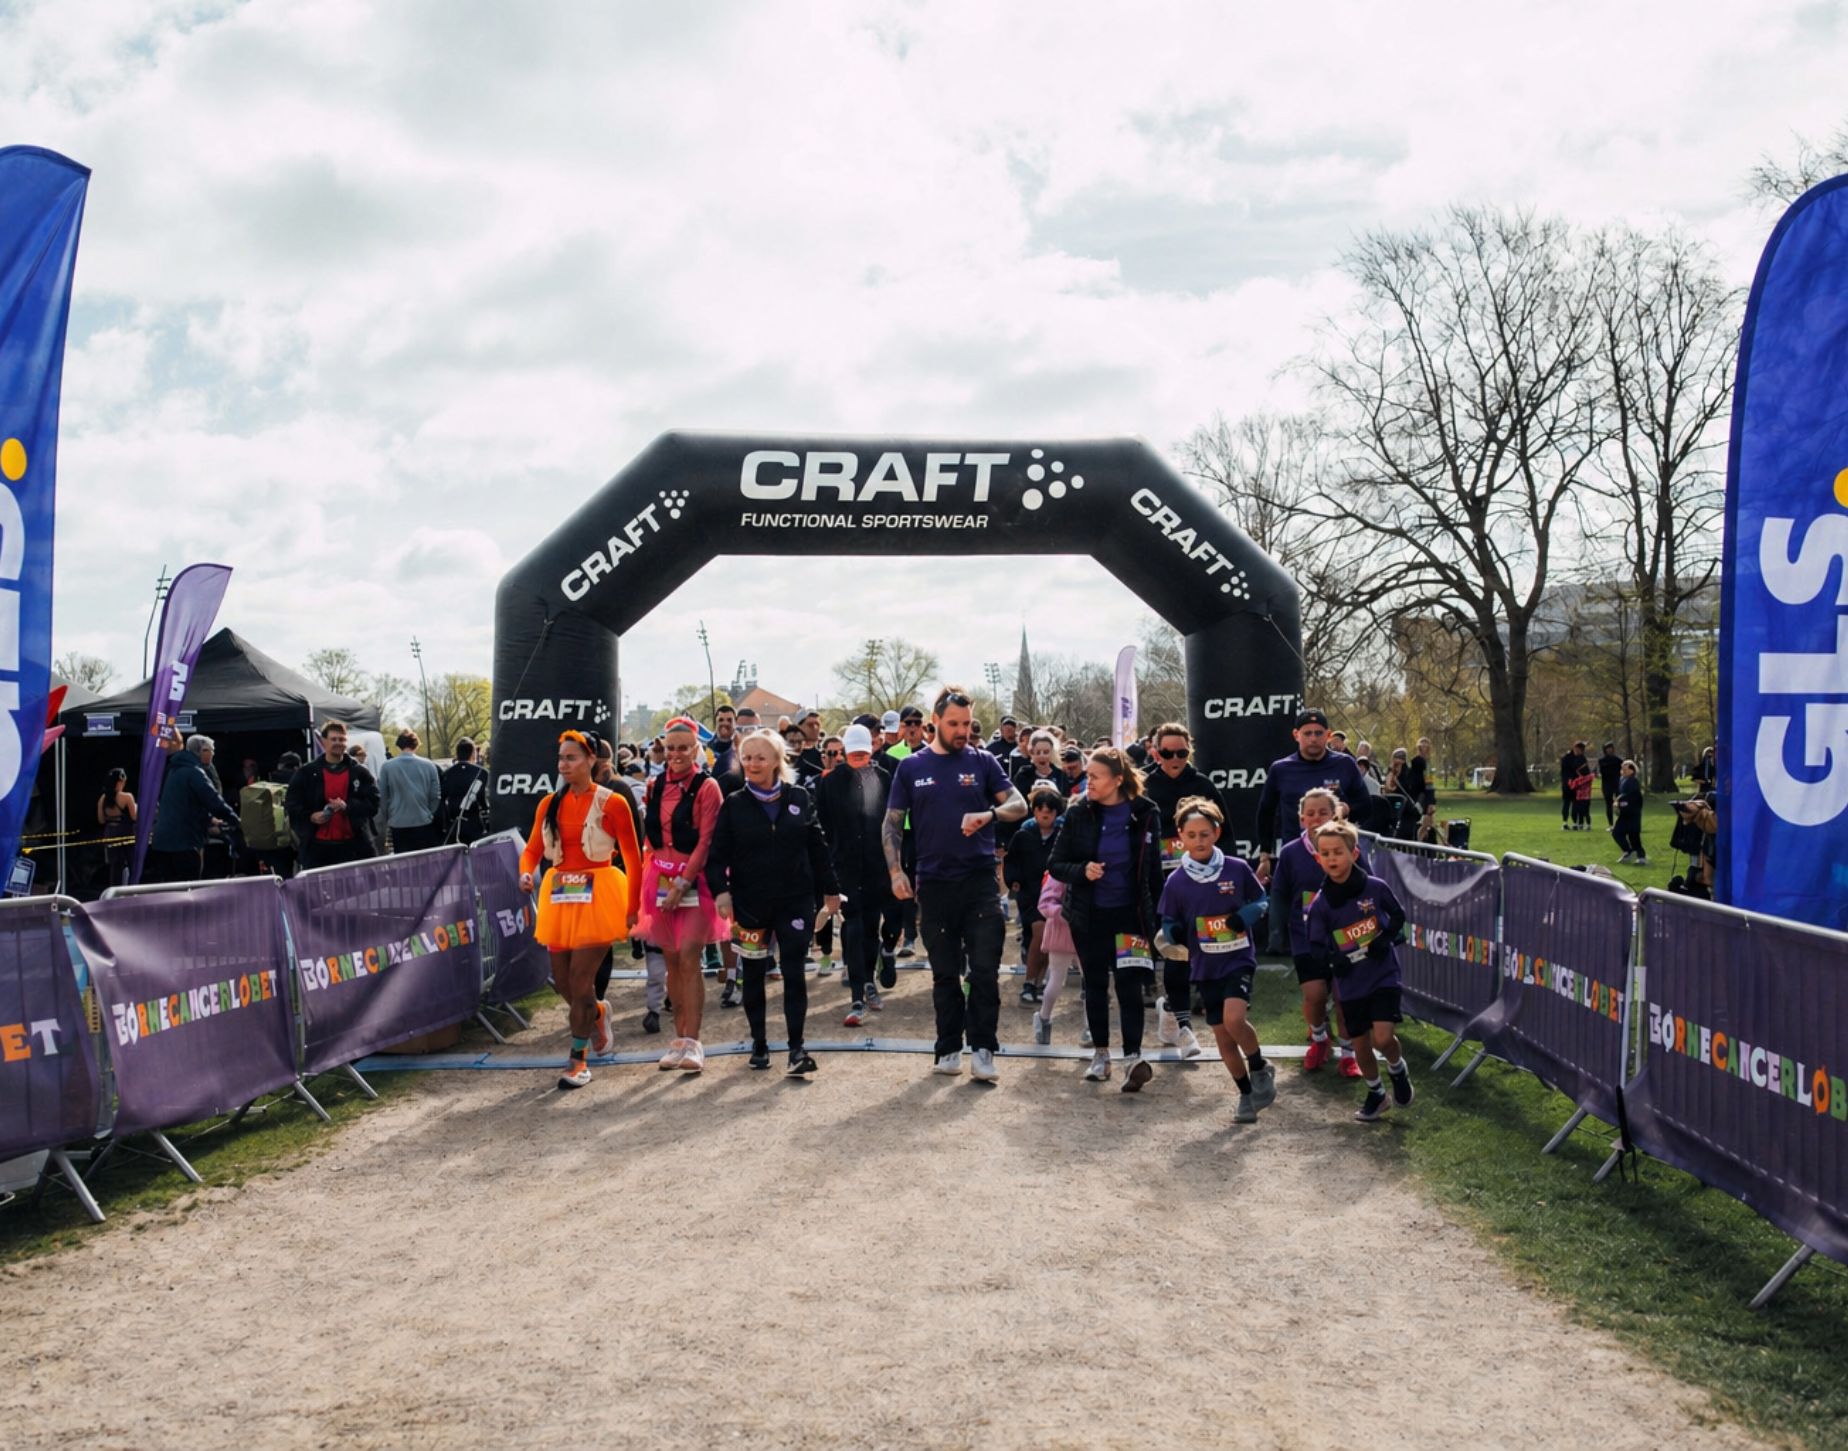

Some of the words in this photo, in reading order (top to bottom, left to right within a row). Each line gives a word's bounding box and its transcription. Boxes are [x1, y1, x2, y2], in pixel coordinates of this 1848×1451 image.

[740, 450, 1011, 502] CRAFT
[740, 512, 857, 528] FUNCTIONAL
[861, 513, 989, 529] SPORTSWEAR
[1129, 487, 1235, 577] CRAFT
[560, 502, 662, 601] CRAFT
[499, 699, 592, 720] CRAFT
[1204, 694, 1295, 719] CRAFT
[496, 773, 565, 794] CRA
[1209, 767, 1269, 789] CRA
